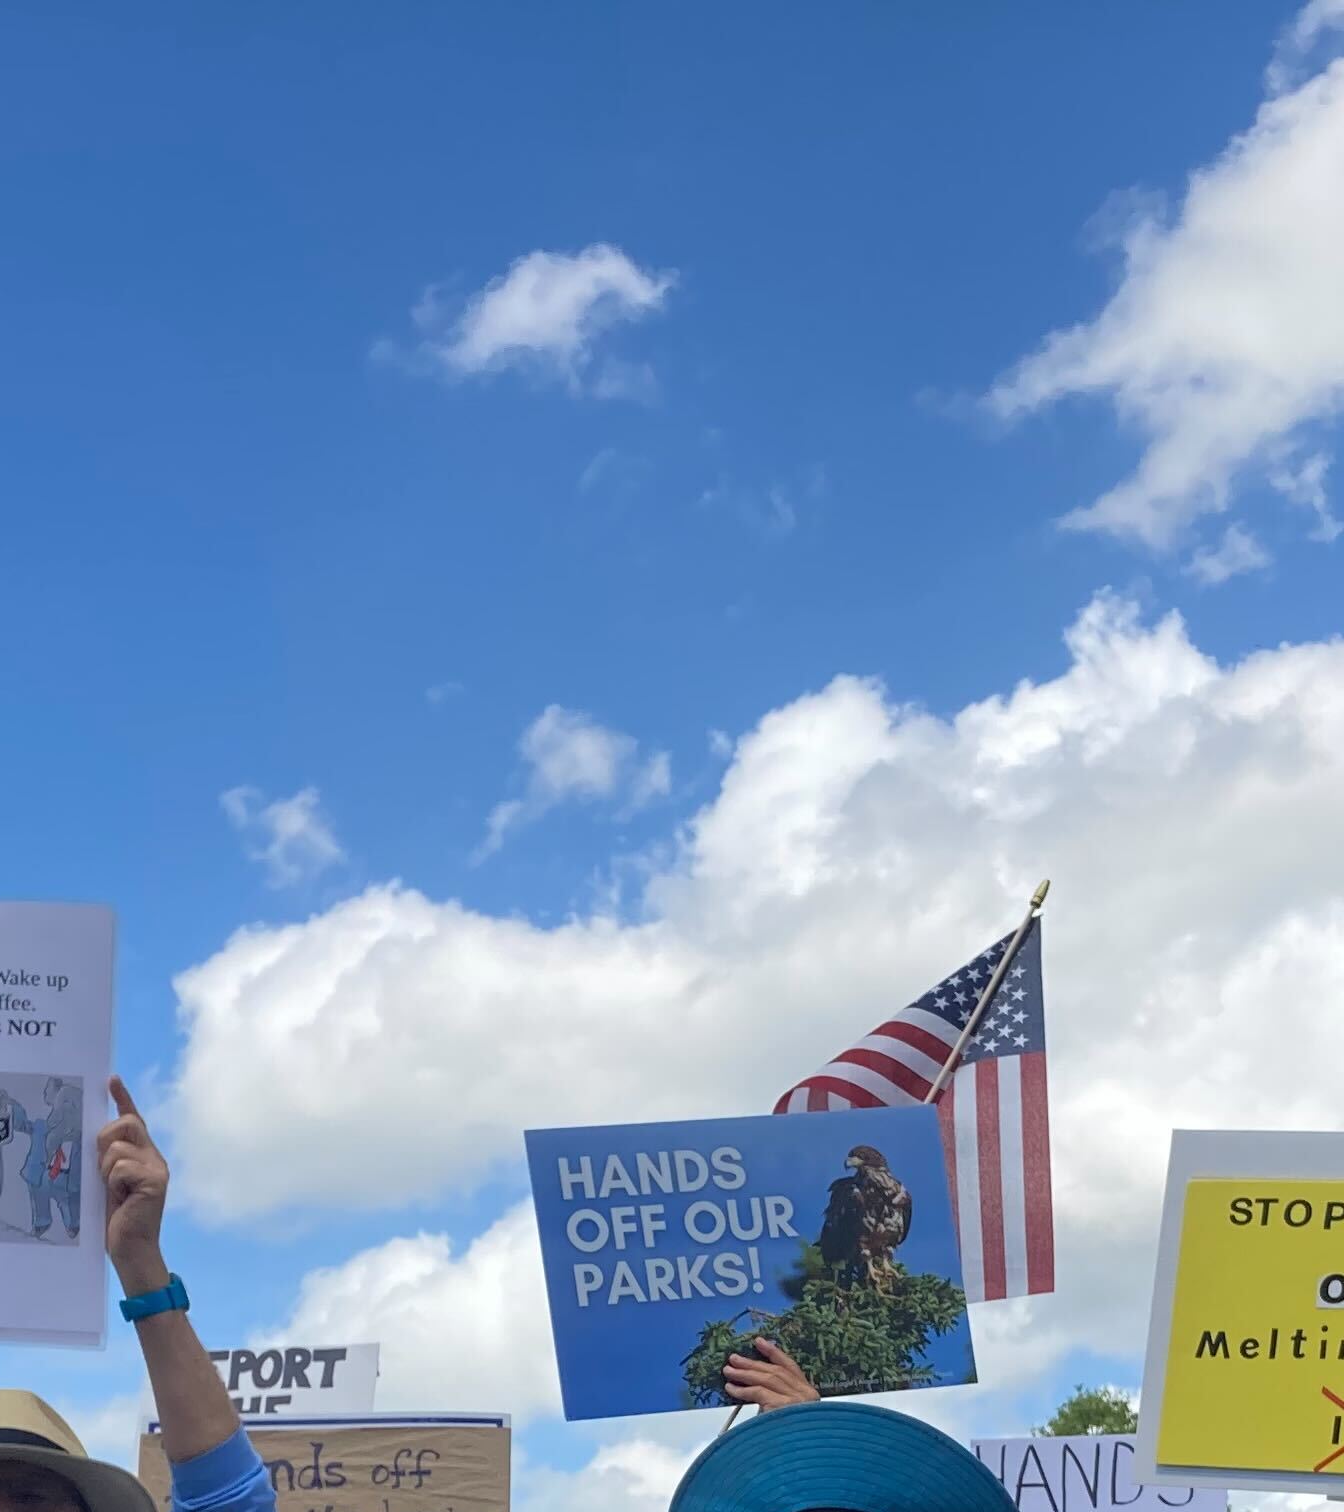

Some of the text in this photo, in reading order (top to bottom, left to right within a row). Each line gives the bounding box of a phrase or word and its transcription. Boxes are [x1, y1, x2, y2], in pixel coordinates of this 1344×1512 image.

[46, 972, 69, 990] up
[7, 1019, 56, 1037] NOT
[557, 1146, 747, 1200] HANDS
[566, 1195, 799, 1253] OFF OUR
[574, 1247, 765, 1308] PARKS!
[211, 1347, 346, 1390] PORT
[371, 1448, 440, 1489] off
